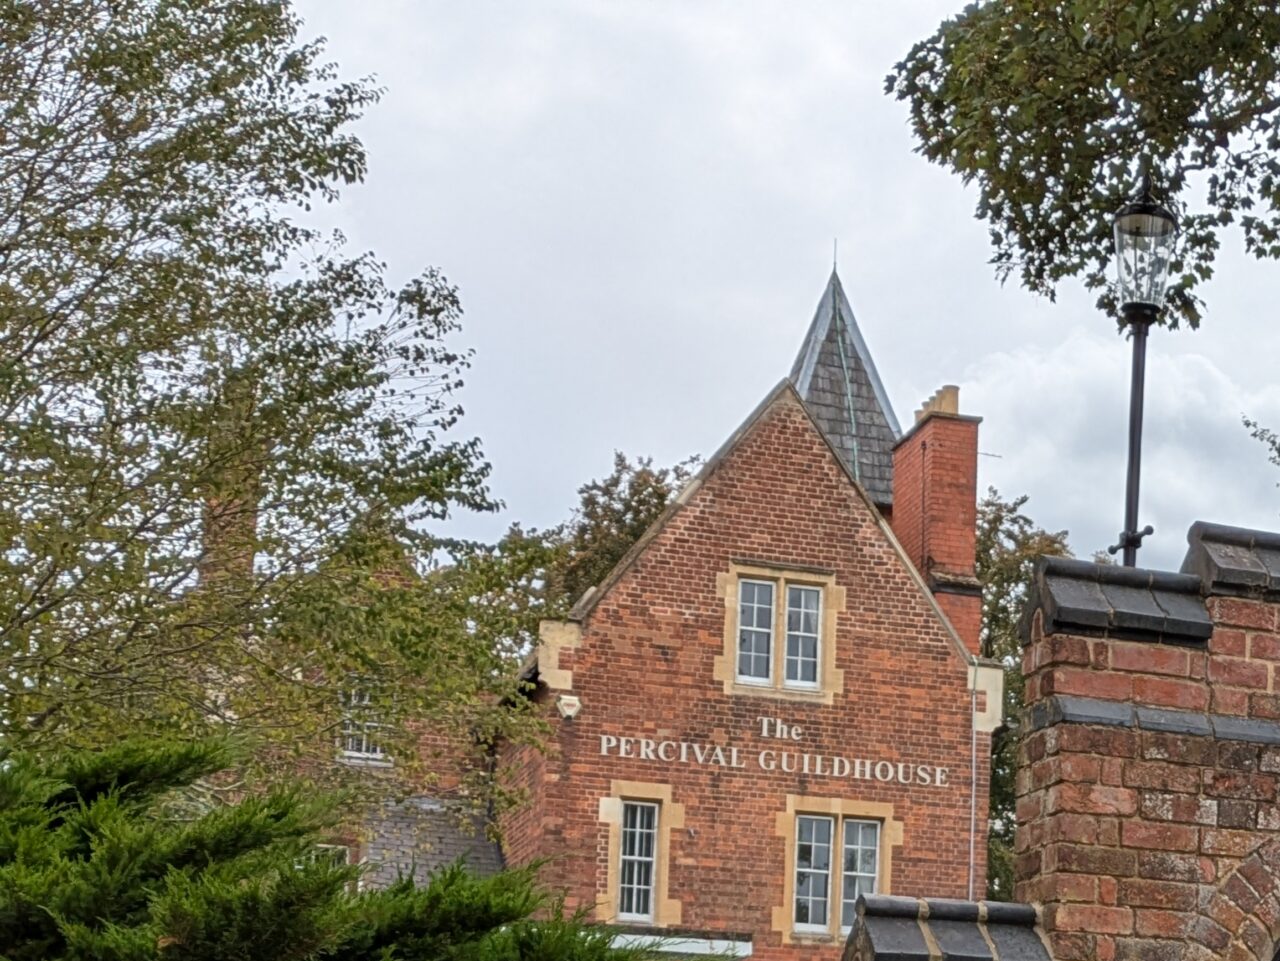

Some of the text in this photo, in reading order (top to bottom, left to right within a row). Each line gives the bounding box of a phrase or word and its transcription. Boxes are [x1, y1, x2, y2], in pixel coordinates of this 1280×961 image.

[757, 716, 802, 740] The
[600, 734, 950, 787] PERCIVAL GUILDHOUSE
